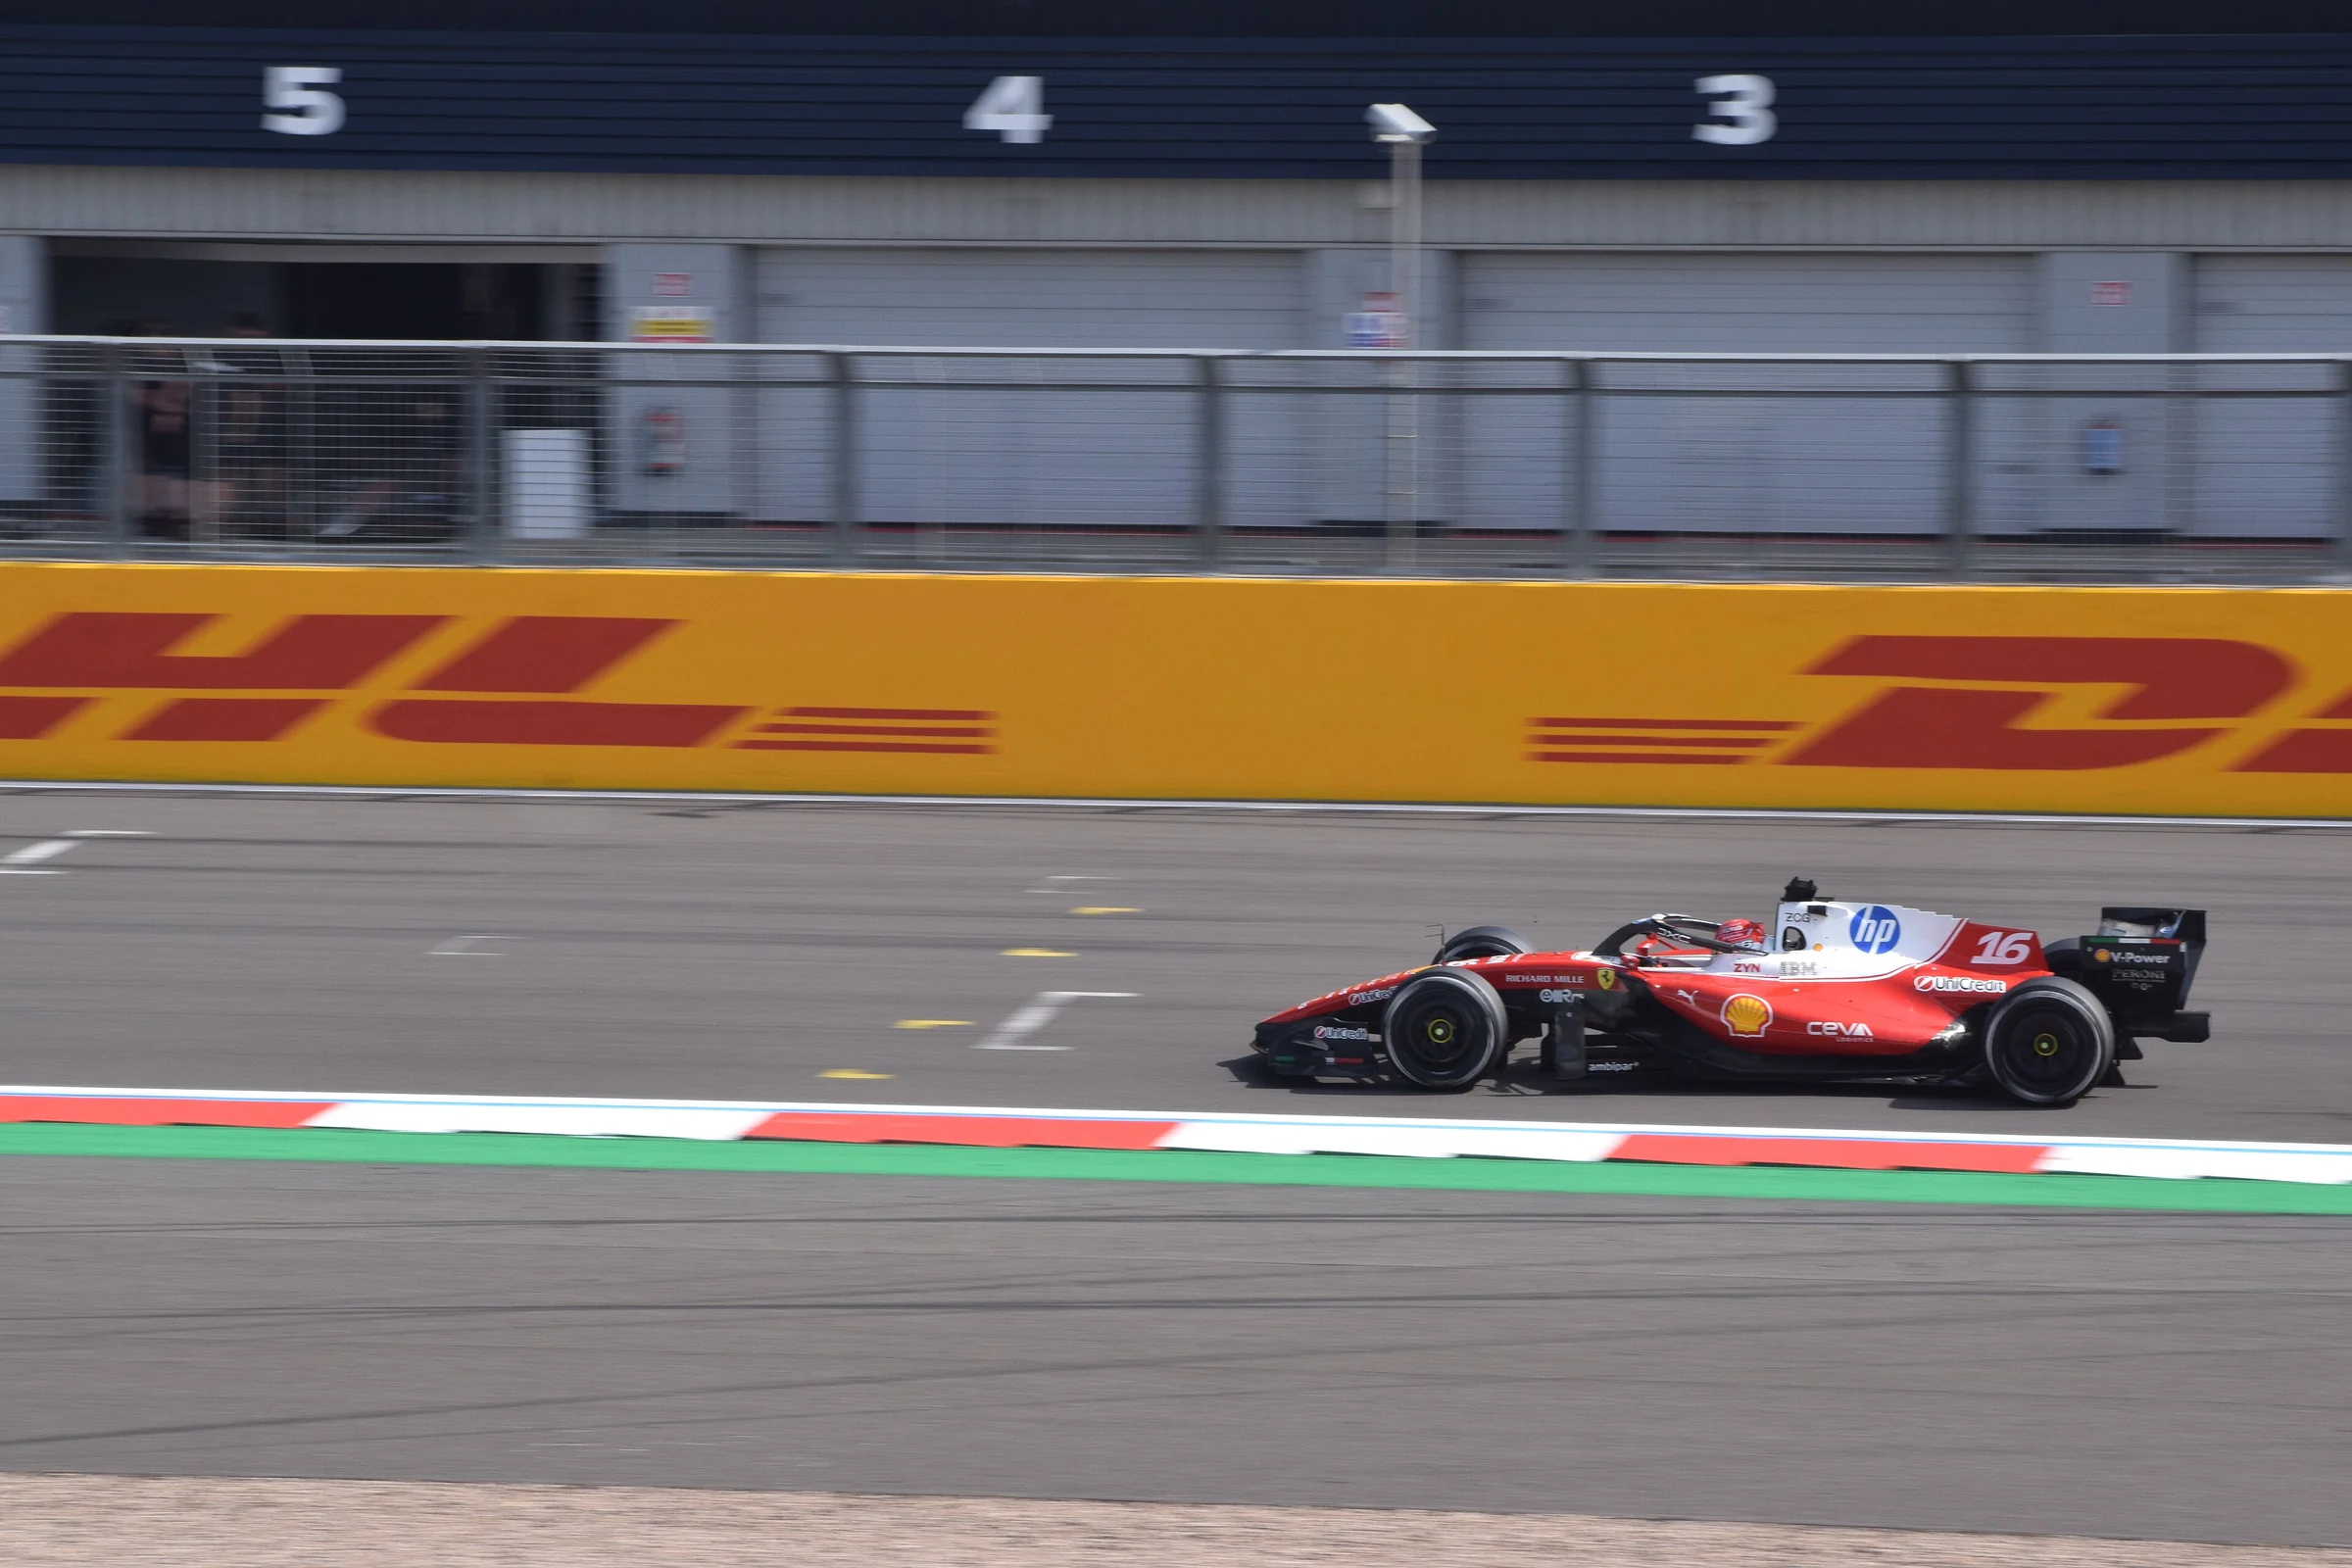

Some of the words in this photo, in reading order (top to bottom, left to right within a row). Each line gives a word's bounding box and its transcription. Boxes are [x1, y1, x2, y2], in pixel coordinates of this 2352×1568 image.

[261, 67, 347, 135] 5
[963, 76, 1054, 144] 4
[1692, 74, 1778, 145] 3
[1854, 906, 1897, 955] hp
[1970, 931, 2034, 965] 16
[2111, 952, 2171, 964] V-Power
[1505, 974, 1551, 983] RICHARD
[1553, 975, 1585, 984] MILLE
[1734, 963, 1761, 973] ZYN
[1780, 961, 1817, 977] IBM
[1935, 977, 2005, 992] UniCredit
